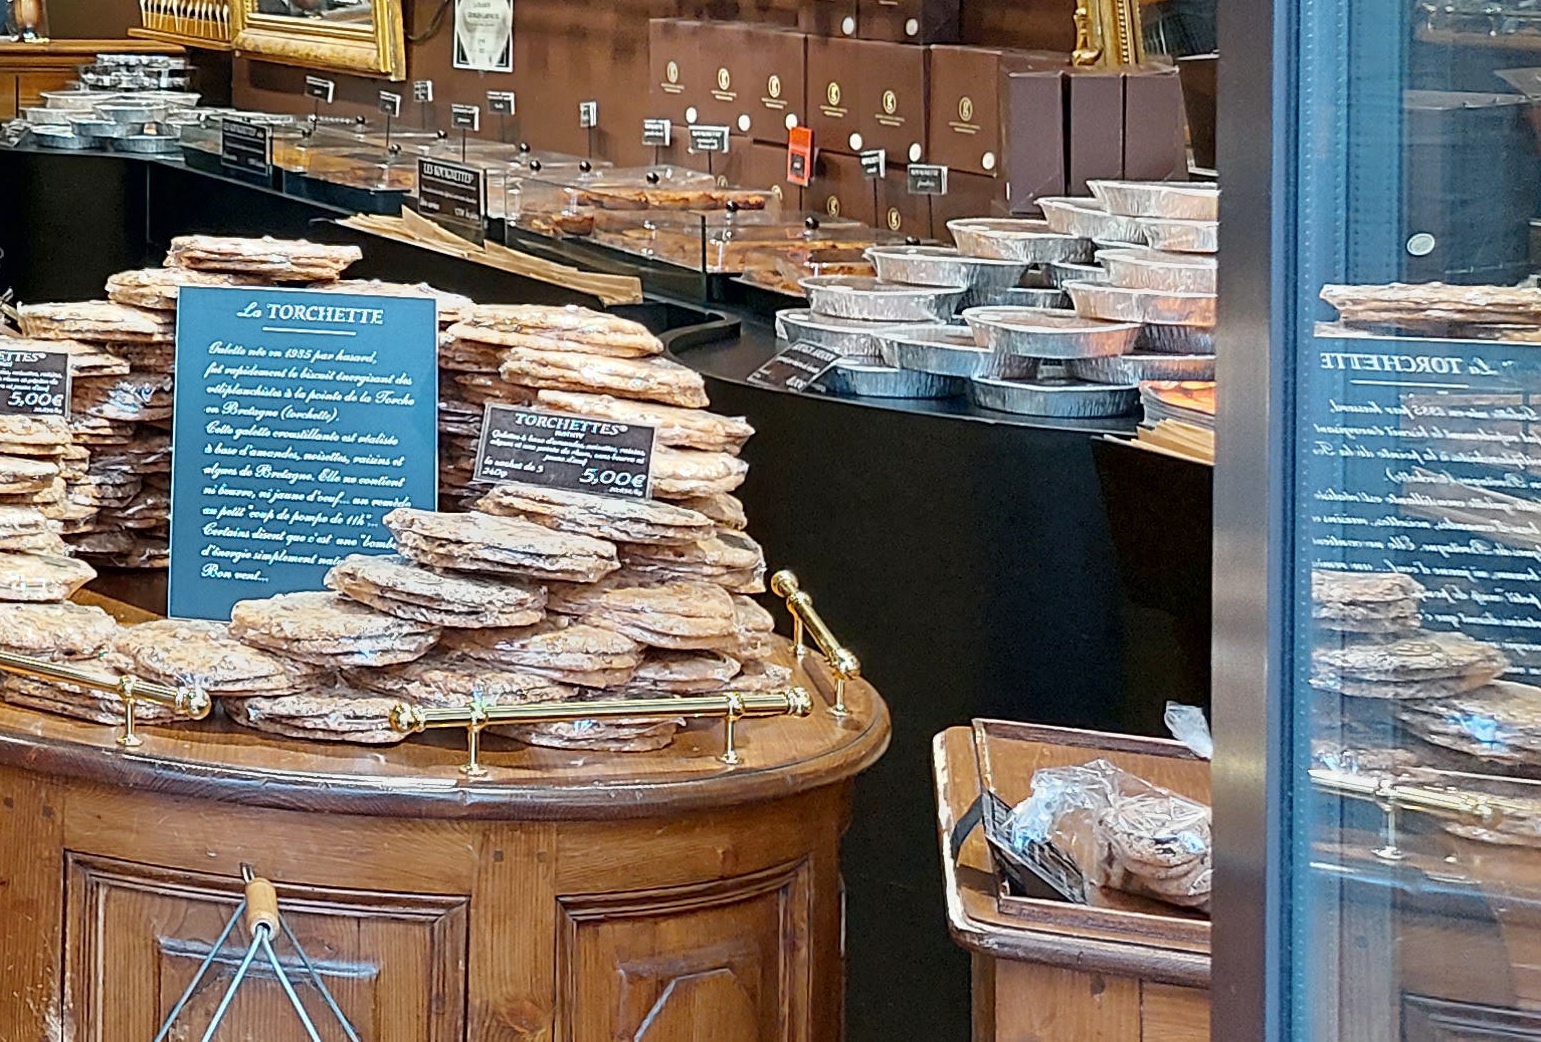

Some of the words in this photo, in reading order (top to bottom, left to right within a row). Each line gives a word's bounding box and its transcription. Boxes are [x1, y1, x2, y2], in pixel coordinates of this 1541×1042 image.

[237, 301, 262, 318] La
[267, 303, 384, 325] TORCHETTE
[208, 341, 246, 355] Galette
[248, 347, 267, 357] née
[310, 350, 334, 363] par
[335, 349, 377, 364] hasard,
[203, 361, 225, 379] fut
[224, 364, 288, 379] rapidement
[287, 366, 298, 378] le
[300, 366, 336, 381] biscuit
[336, 371, 395, 387] énergisant
[395, 372, 412, 385] des
[7, 391, 64, 407] 5,00€
[206, 382, 282, 399] véliplanchistes
[284, 388, 292, 398] à
[294, 387, 306, 398] la
[305, 389, 343, 403] pointe
[344, 390, 357, 402] de
[359, 390, 371, 403] la
[375, 390, 415, 405] Torche
[205, 406, 219, 414] en
[221, 401, 278, 421] Bretagne
[281, 404, 340, 423] (torchette).
[205, 420, 234, 434] Cette
[233, 424, 271, 441] galette
[272, 428, 340, 441] croustillante
[341, 433, 358, 443] est
[358, 432, 399, 446] réalisée
[204, 443, 213, 454] à
[214, 442, 238, 455] base
[353, 453, 390, 466] raisins
[392, 456, 405, 467] et
[202, 462, 237, 479] algues
[239, 464, 253, 476] de
[254, 464, 316, 484] Bretagne.
[318, 468, 341, 482] Elle
[343, 476, 358, 484] ne
[358, 476, 406, 488] contient
[579, 468, 647, 487] 5,00€
[202, 484, 218, 495] ni
[258, 488, 274, 498] ni
[268, 488, 305, 504] jaune
[352, 497, 369, 506] un
[371, 496, 412, 507] remède
[202, 507, 218, 515] au
[216, 505, 246, 520] petit
[276, 508, 290, 520] de
[288, 510, 328, 527] pompe
[329, 512, 343, 524] de
[202, 522, 250, 538] Certains
[251, 526, 287, 541] disent
[285, 534, 306, 546] que
[307, 532, 333, 544] c'est
[336, 537, 357, 546] une
[201, 544, 252, 564] d'énergie
[252, 549, 317, 565] simplement
[201, 563, 232, 578] Bon
